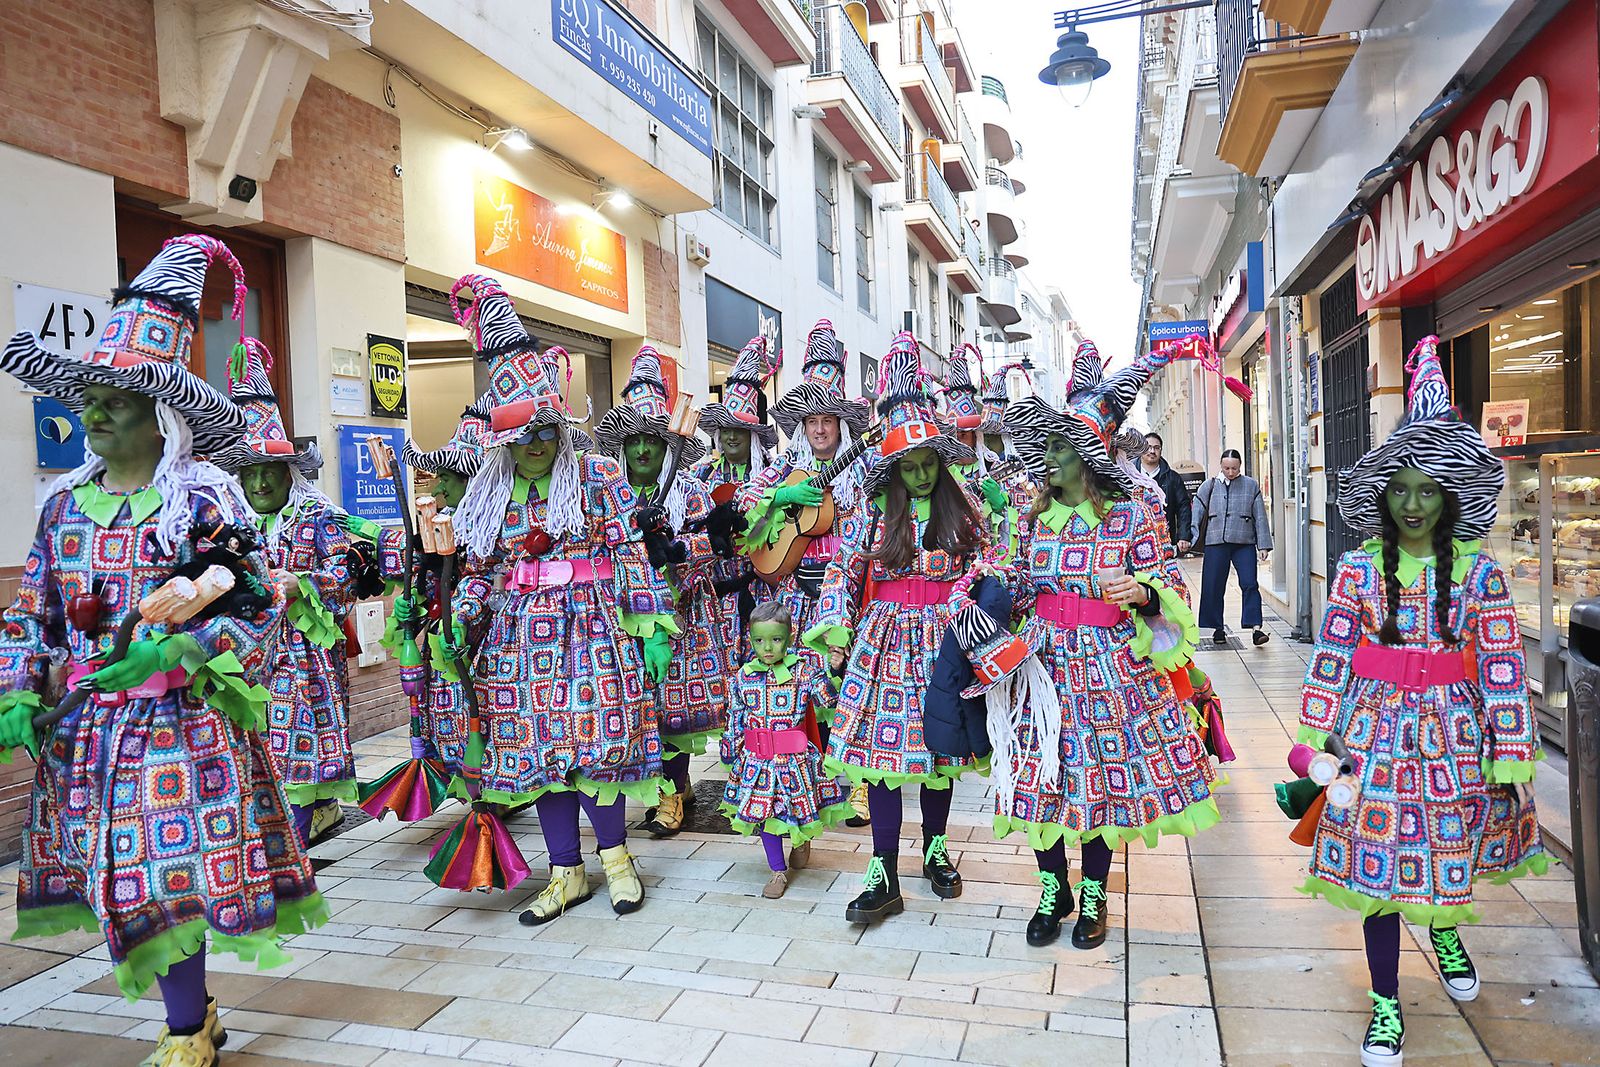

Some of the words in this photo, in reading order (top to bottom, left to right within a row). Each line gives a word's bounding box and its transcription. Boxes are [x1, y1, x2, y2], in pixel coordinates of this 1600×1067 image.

[560, 15, 592, 54] Fincas
[595, 3, 708, 127] Inmobiliaria
[610, 62, 625, 82] 959
[627, 76, 641, 95] 235
[643, 89, 656, 107] 420
[1378, 76, 1548, 293] MAS&GO
[532, 221, 577, 261] Aurora
[581, 279, 619, 299] ZAPATOS
[1151, 326, 1176, 336] óptica
[1177, 325, 1205, 333] urbano
[374, 352, 400, 362] VETTONIA
[356, 480, 396, 496] Fincas
[357, 507, 397, 515] Inmobiliaria
